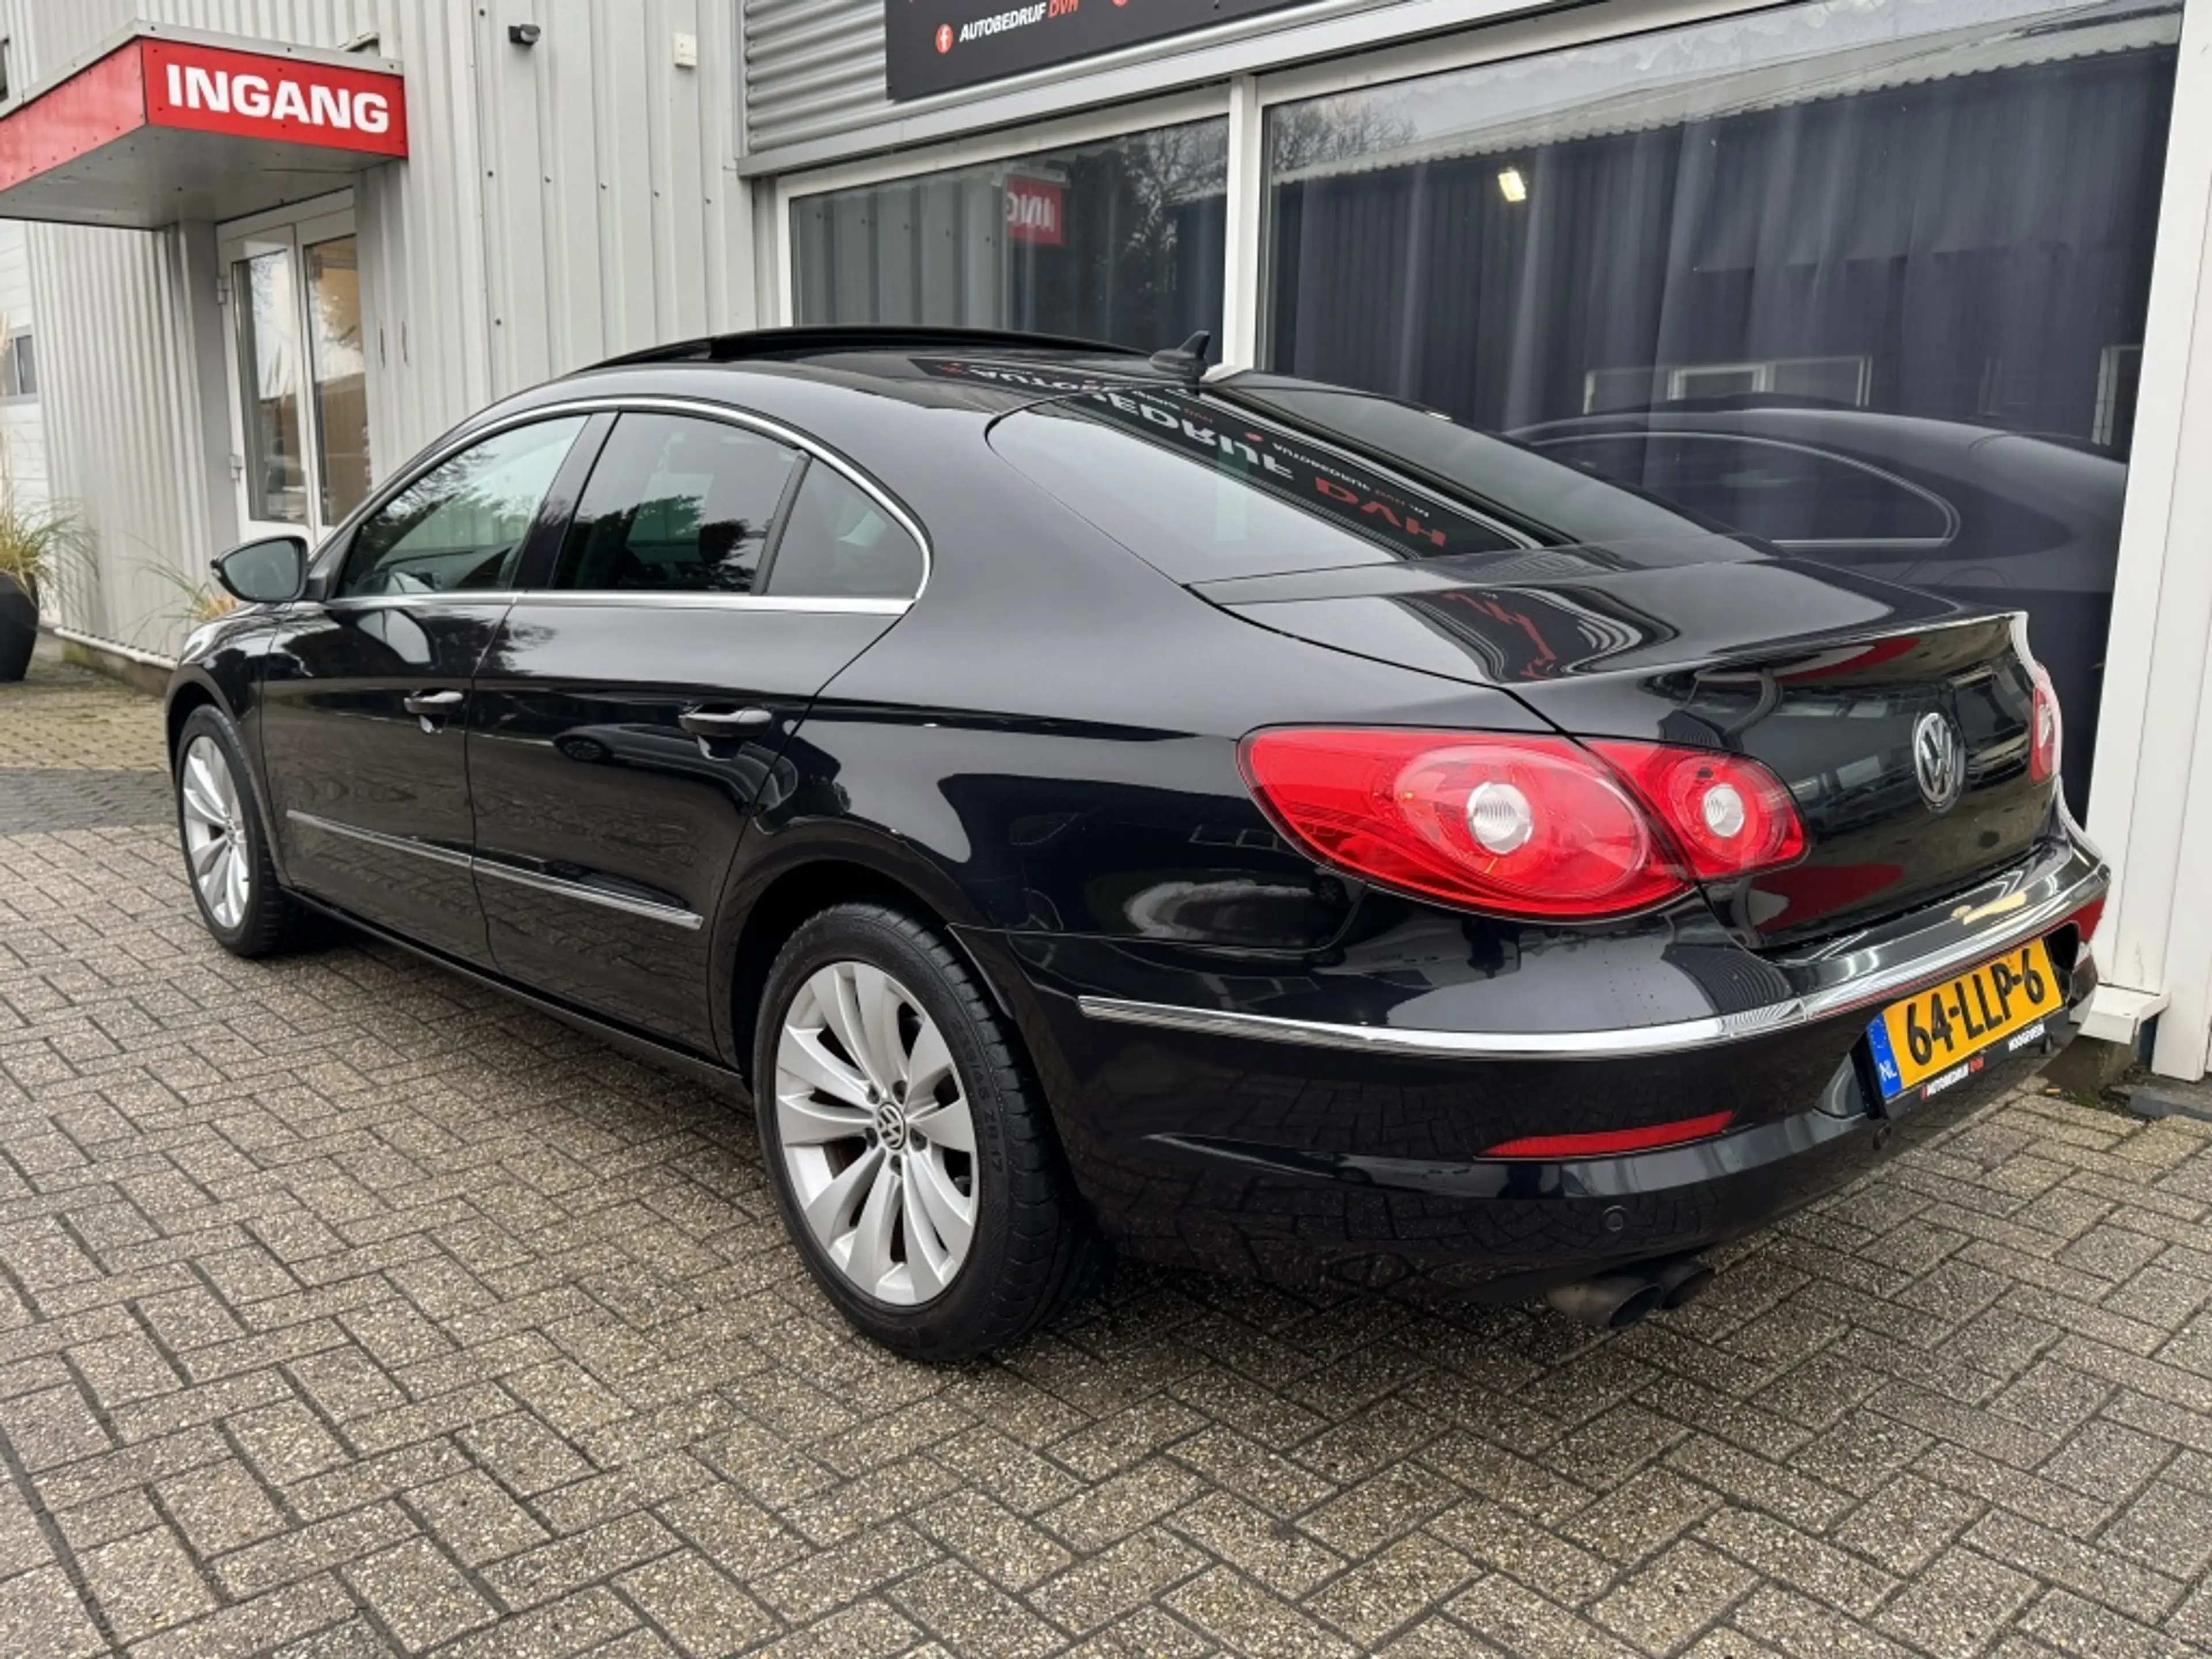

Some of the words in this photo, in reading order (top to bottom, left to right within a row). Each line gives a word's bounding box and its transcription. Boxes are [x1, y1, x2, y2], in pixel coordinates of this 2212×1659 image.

[959, 2, 1047, 43] AUTOBEDRIJF
[166, 64, 389, 133] INGANG
[1907, 948, 2046, 1066] 64-LLP-6
[1878, 1059, 1897, 1081] NL
